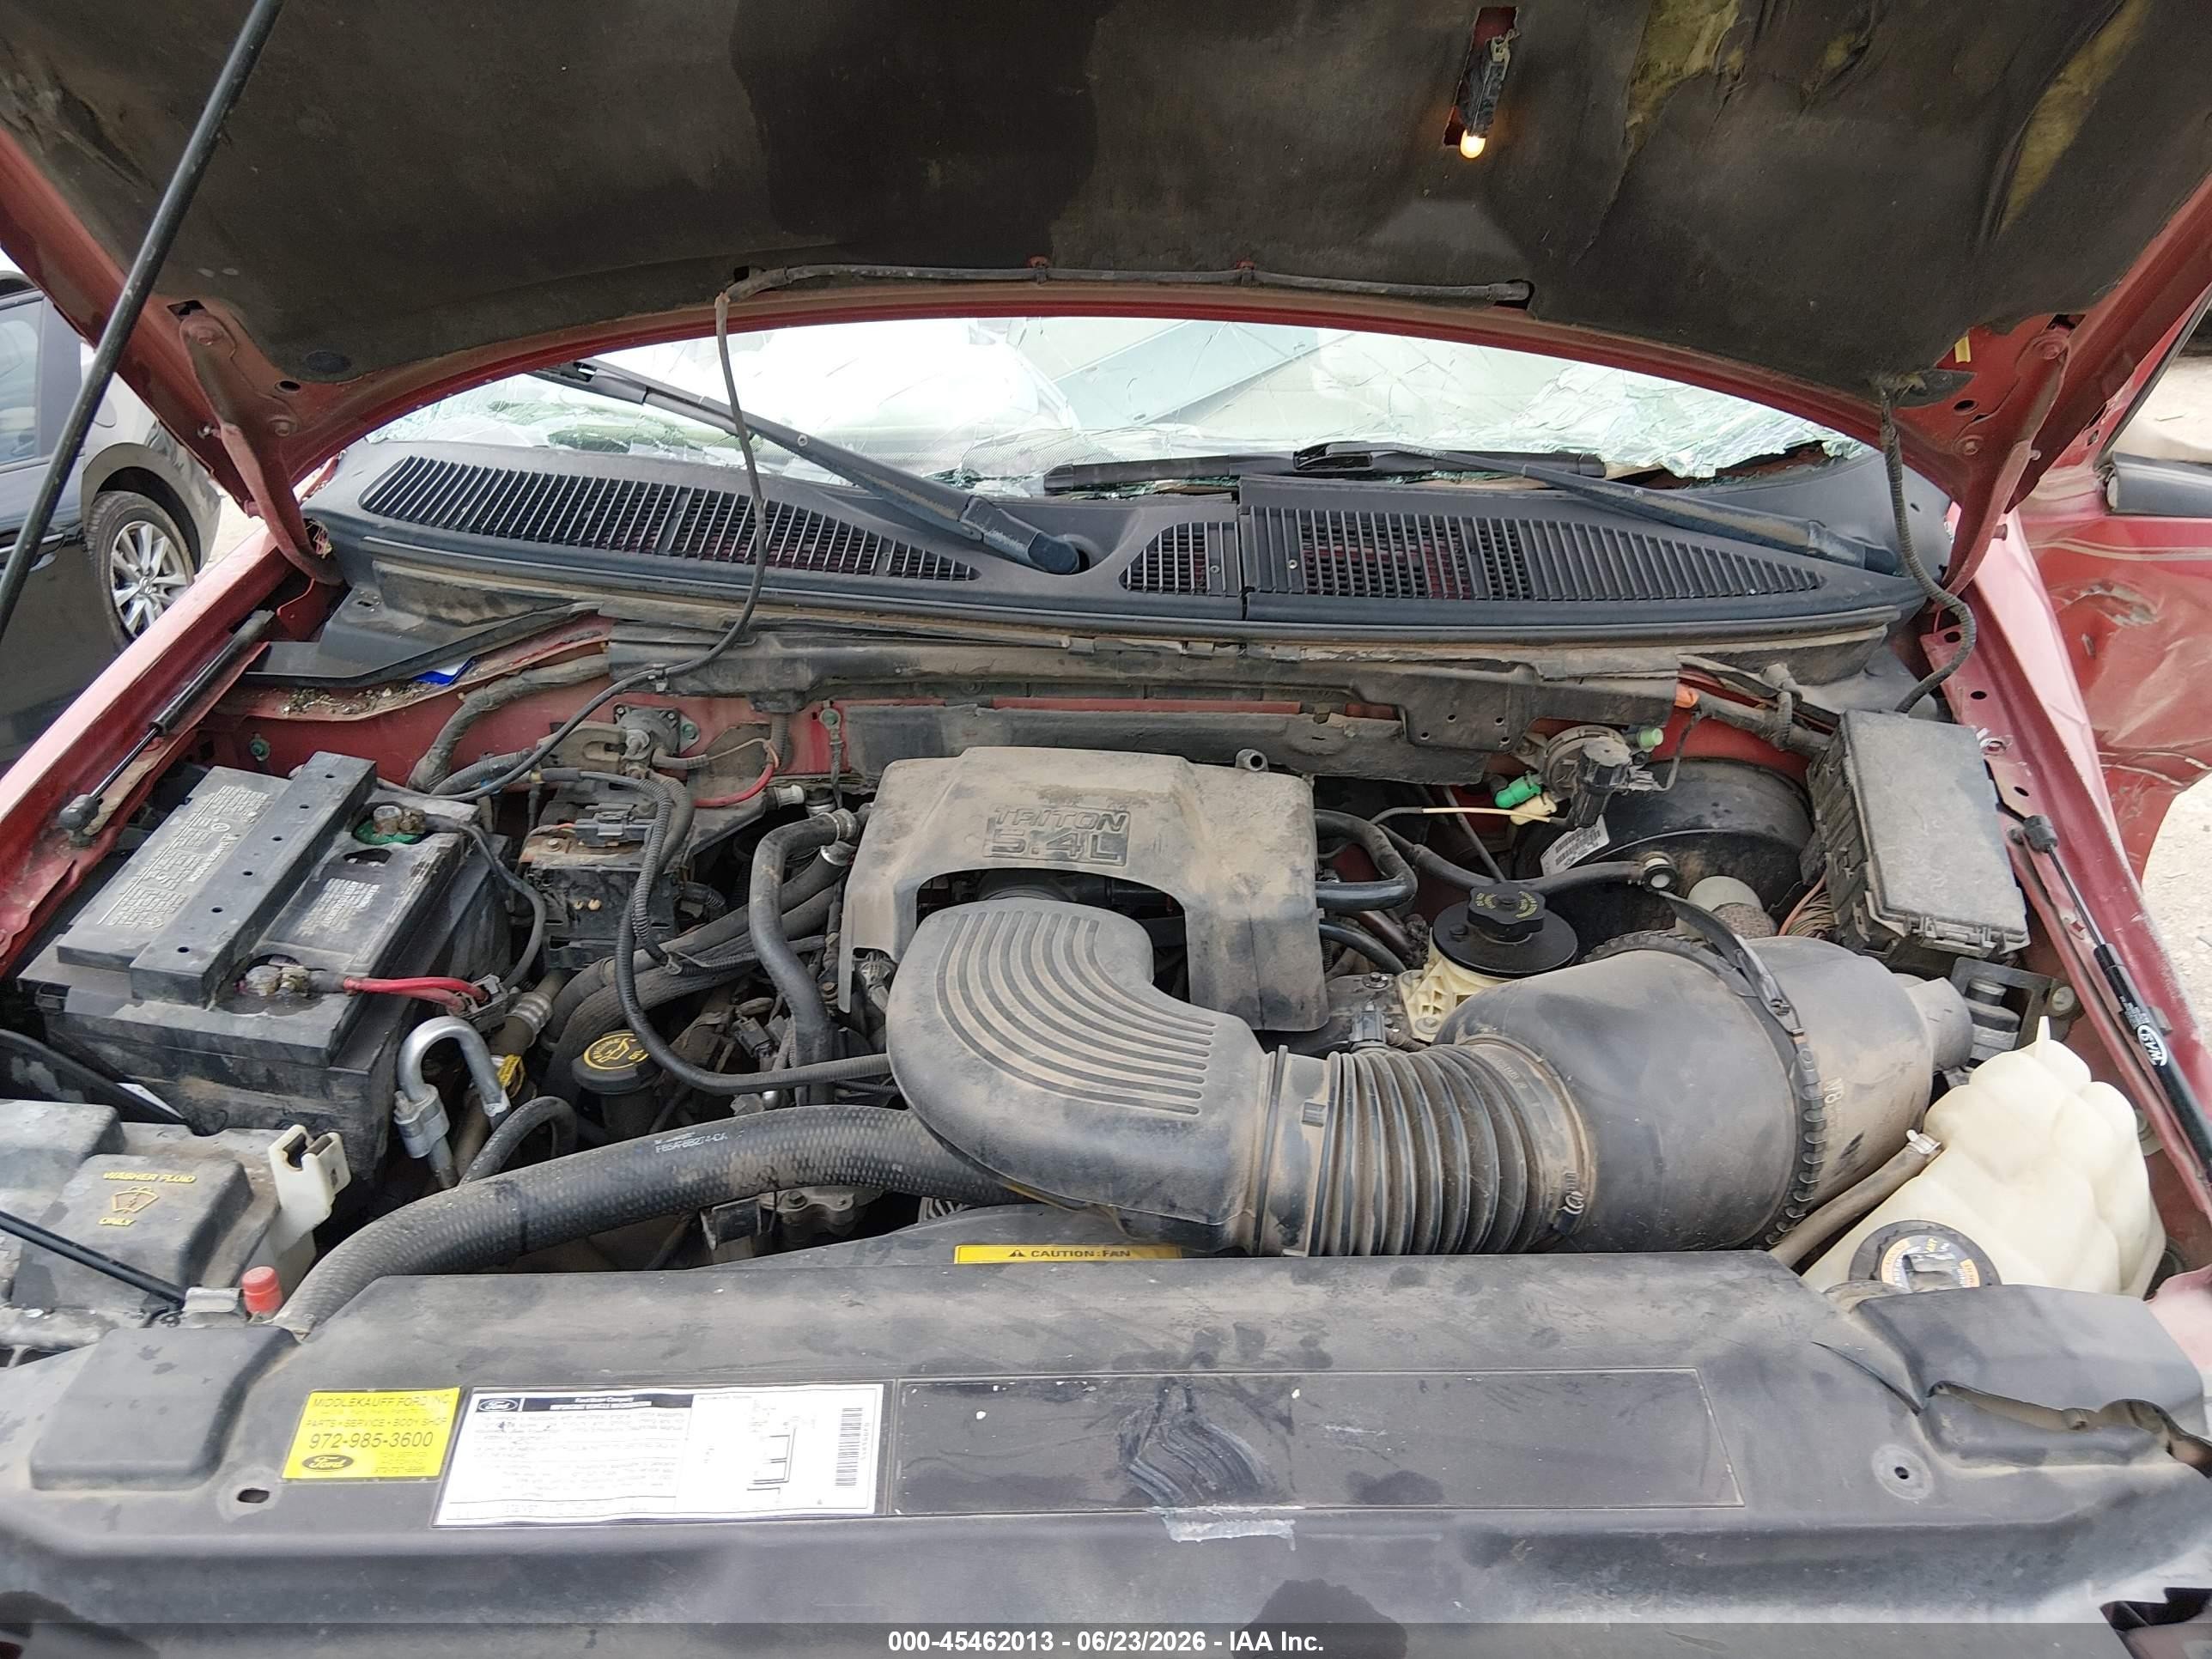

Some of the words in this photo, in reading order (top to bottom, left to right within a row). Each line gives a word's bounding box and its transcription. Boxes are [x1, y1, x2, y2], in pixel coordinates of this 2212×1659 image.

[994, 807, 1127, 832] TRITON
[990, 828, 1121, 860] 5.4L
[103, 1171, 158, 1182] WASHER
[161, 1174, 197, 1183] FLUID
[98, 1216, 137, 1226] ONLY
[1103, 1249, 1131, 1258] FAN
[308, 1431, 434, 1449] 972-985-3600
